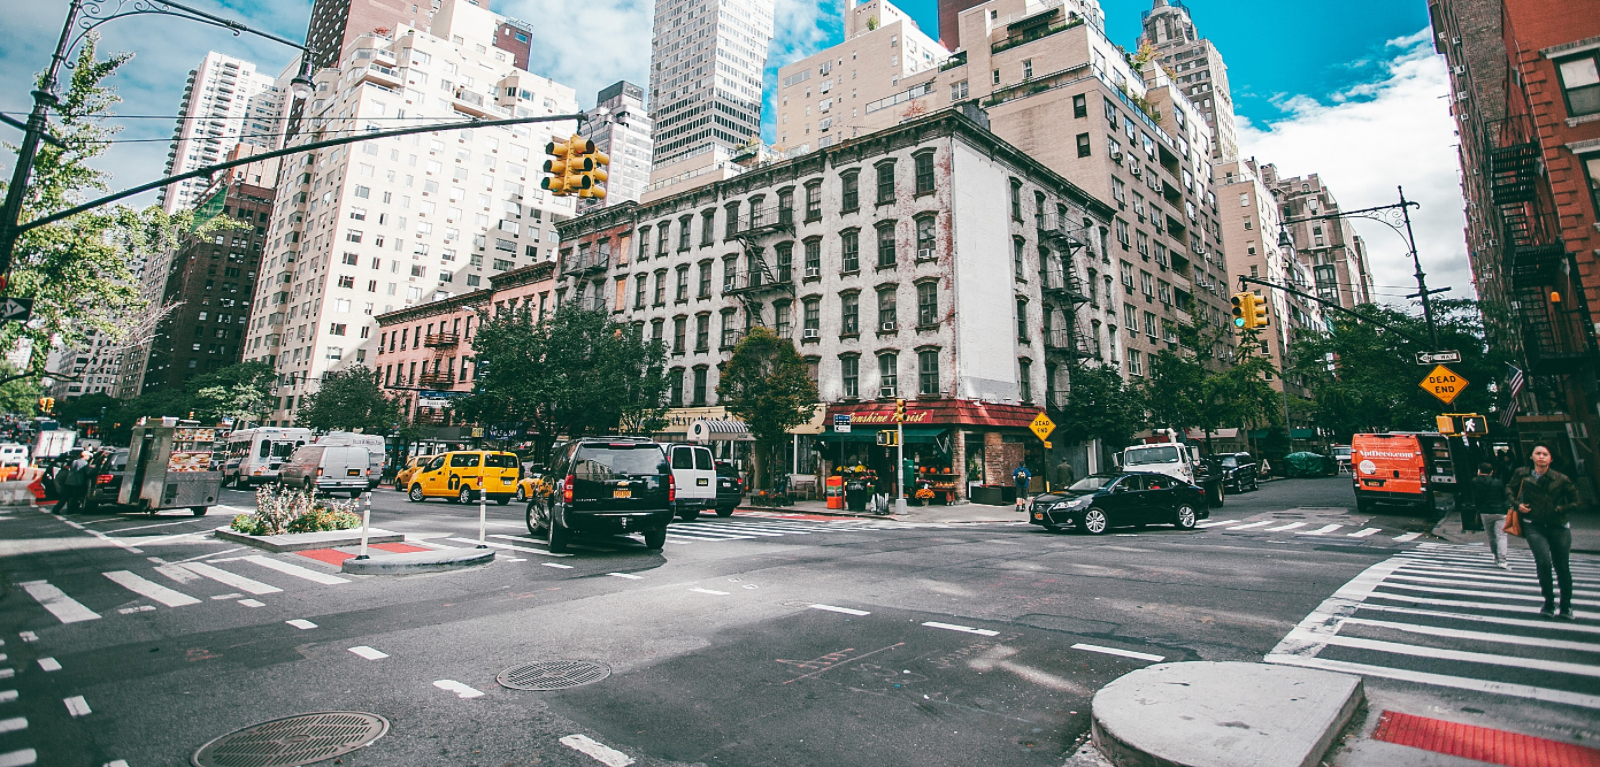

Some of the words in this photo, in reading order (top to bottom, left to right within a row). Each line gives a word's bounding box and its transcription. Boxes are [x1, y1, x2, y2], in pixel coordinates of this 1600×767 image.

[1429, 375, 1456, 384] DEAD
[1434, 385, 1455, 394] END
[850, 411, 888, 423] Sunshine
[890, 411, 927, 423] Frist
[1359, 450, 1414, 459] AptDeco.com
